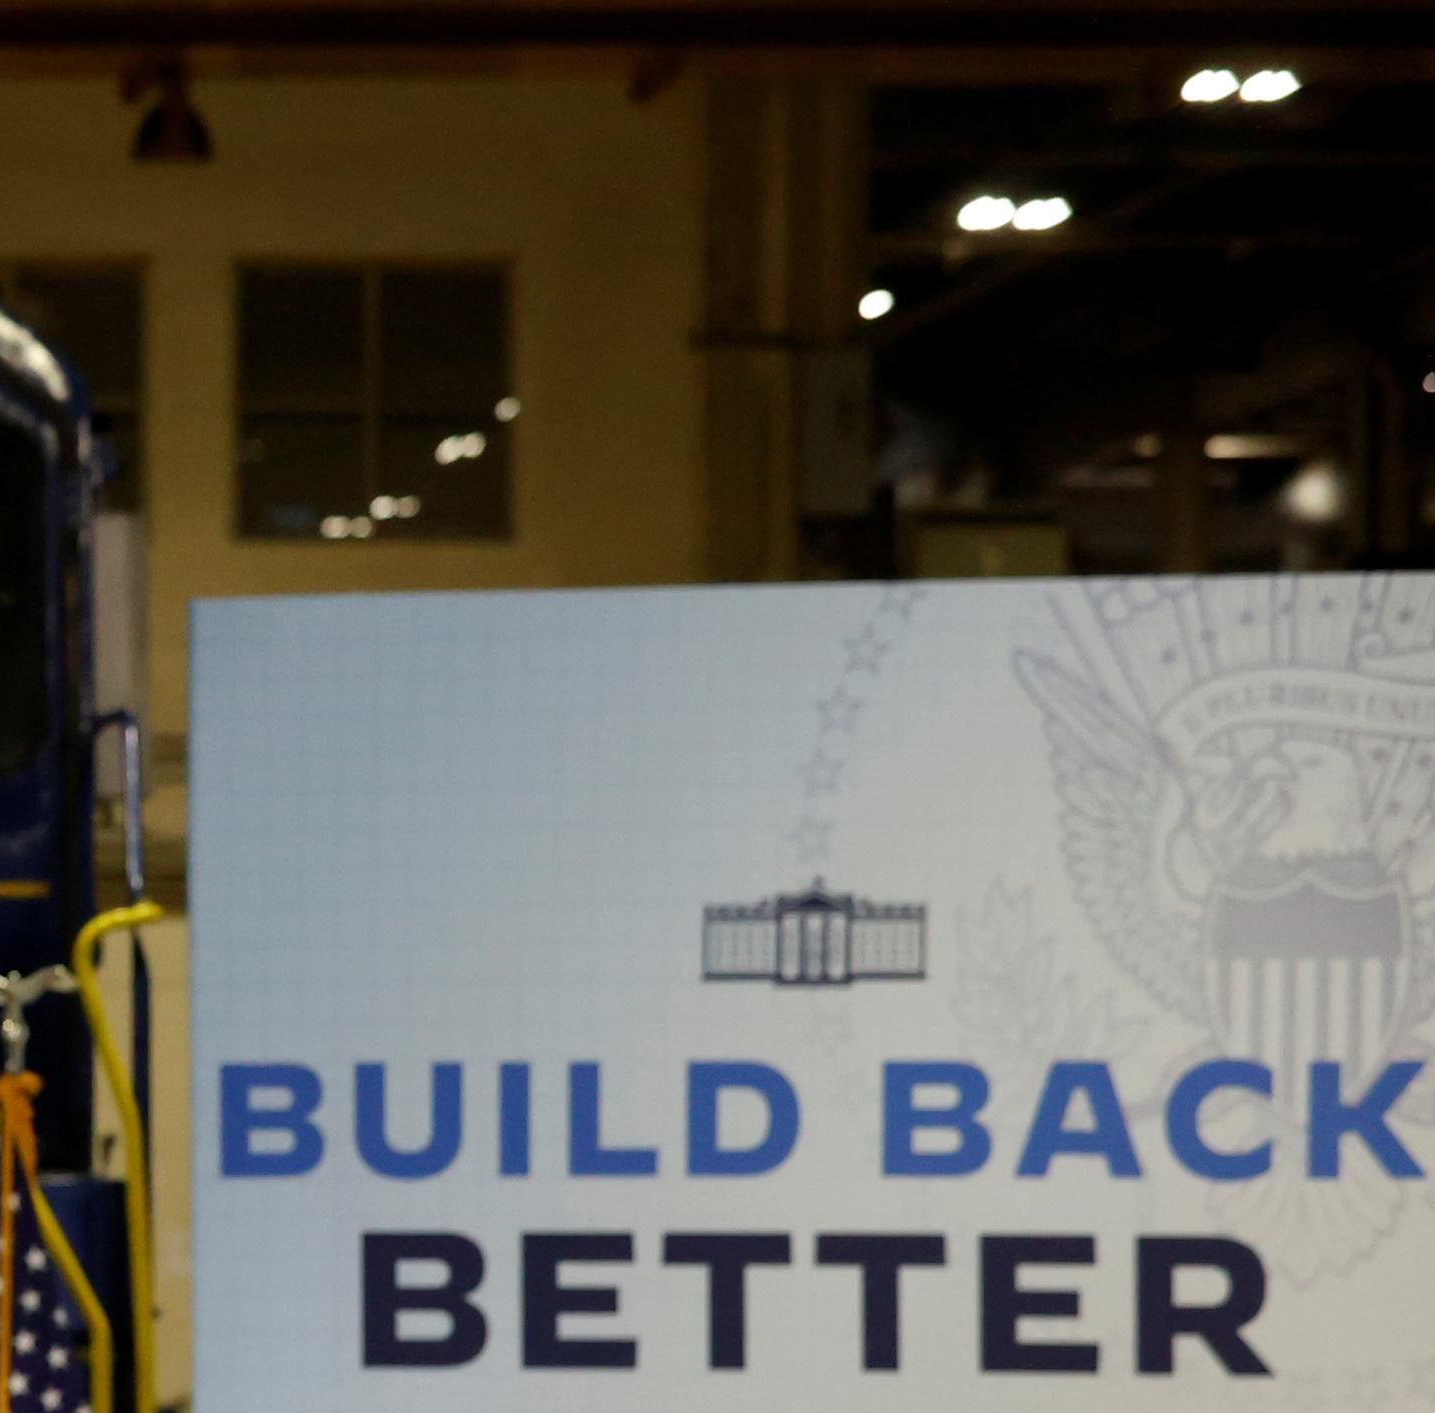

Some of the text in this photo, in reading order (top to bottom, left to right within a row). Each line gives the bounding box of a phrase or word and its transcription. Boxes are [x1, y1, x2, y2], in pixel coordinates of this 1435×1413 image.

[216, 1059, 1427, 1181] BUILD BACK
[361, 1231, 1274, 1378] BETTER
